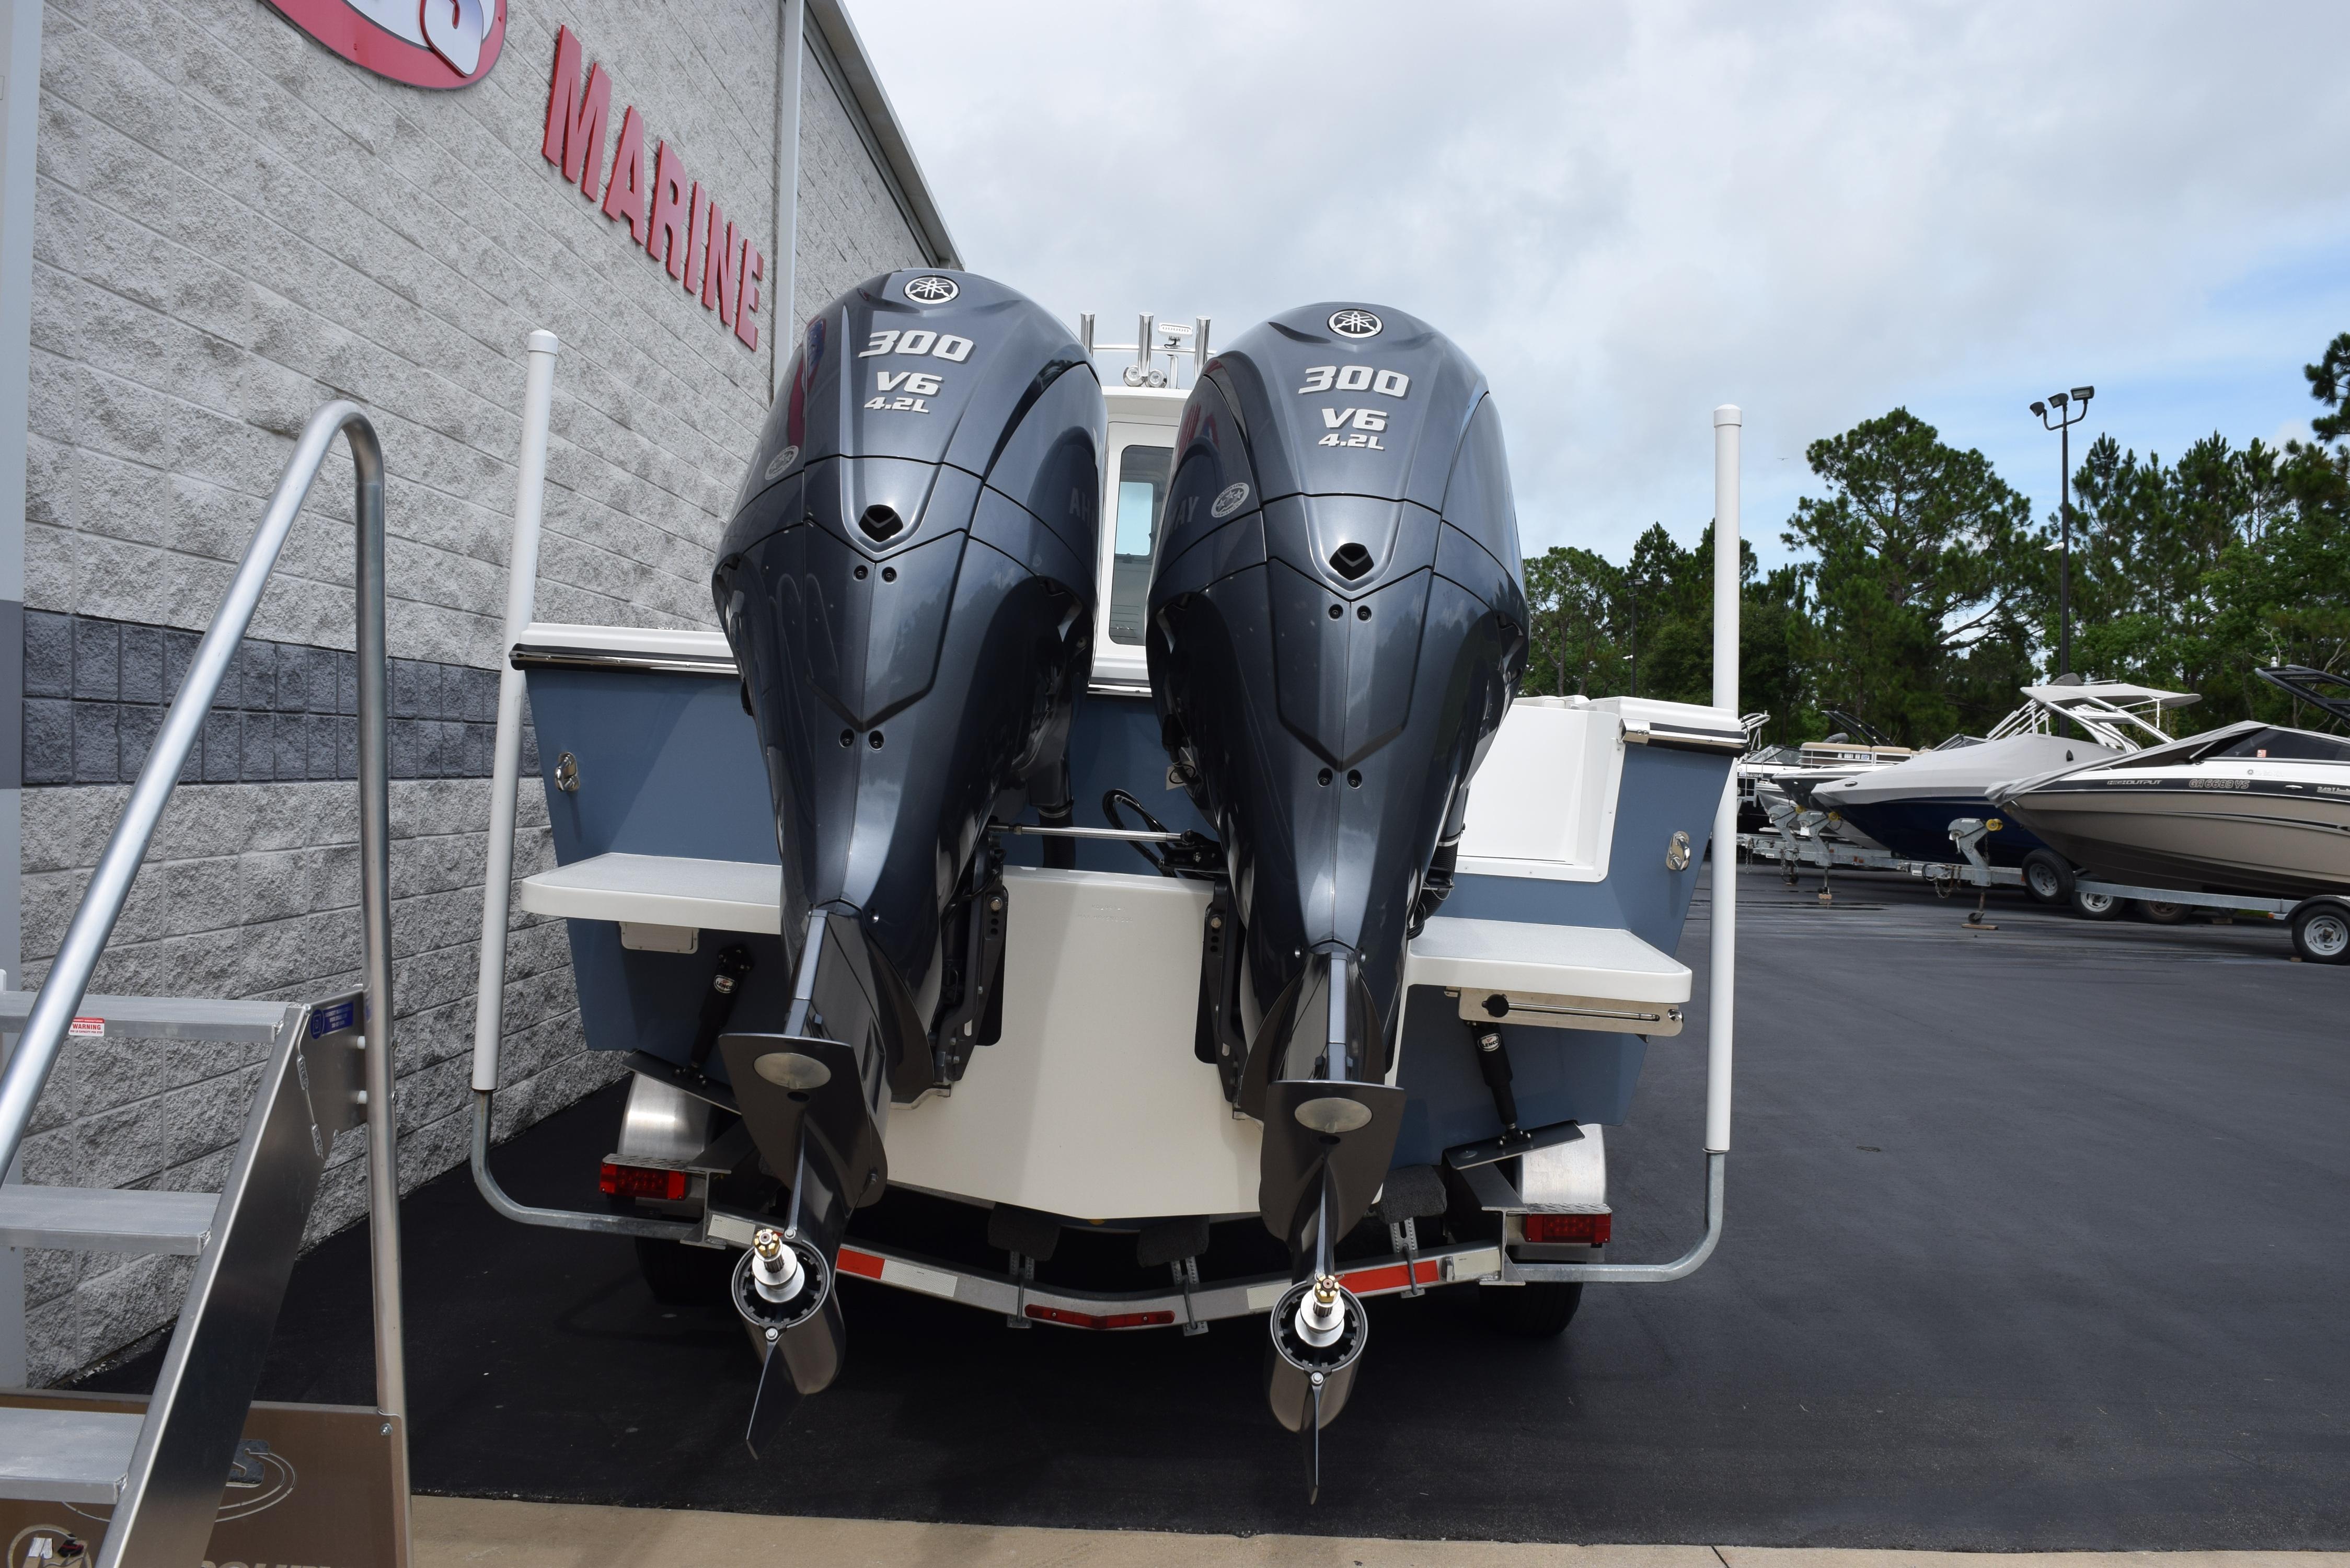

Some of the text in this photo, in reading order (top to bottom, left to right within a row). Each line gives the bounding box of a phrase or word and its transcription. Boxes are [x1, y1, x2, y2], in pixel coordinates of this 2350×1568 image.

[542, 25, 764, 352] MARINE
[858, 330, 974, 362] 300
[877, 372, 943, 395] V6
[1298, 365, 1410, 397] 300
[864, 397, 929, 413] 4.2L
[1321, 408, 1388, 431] V6
[1318, 434, 1385, 450] 4.2L
[1481, 1039, 1499, 1047] LENCO
